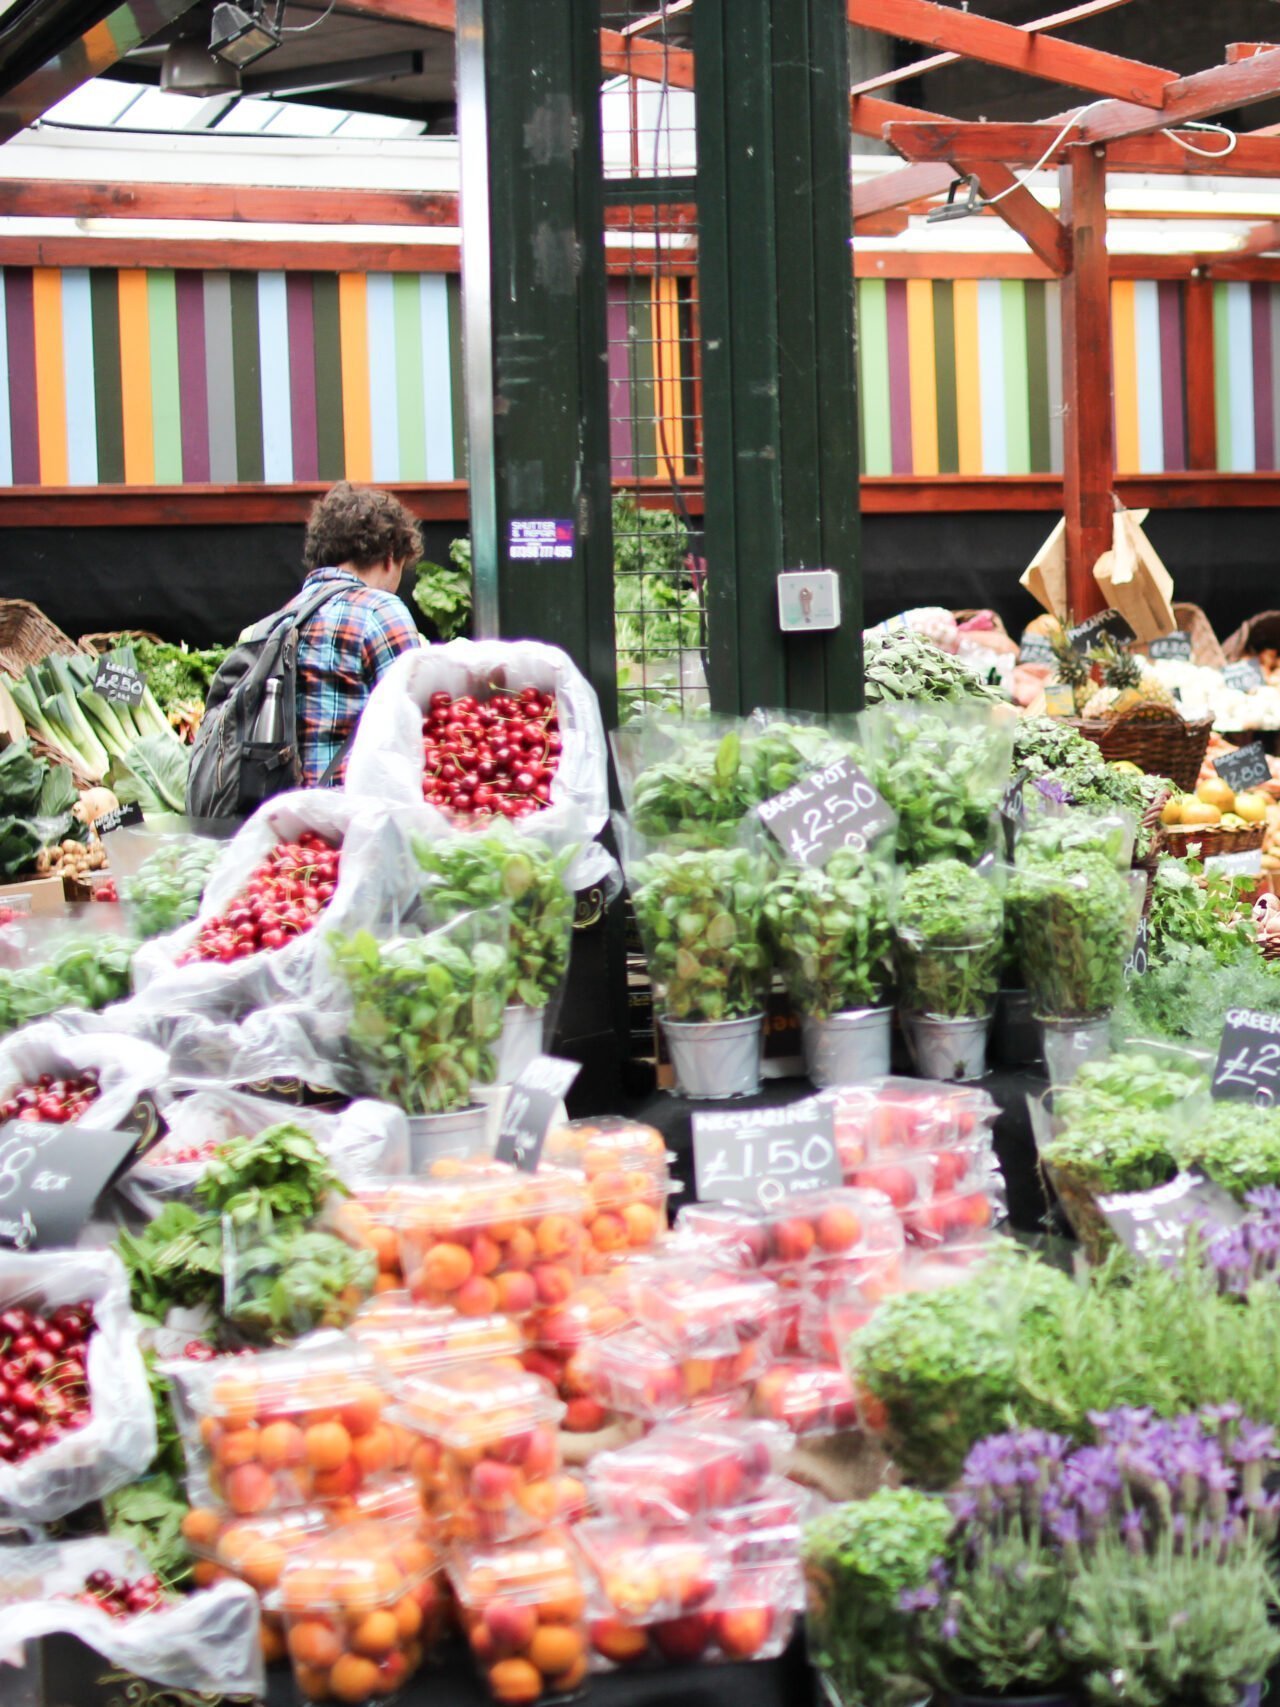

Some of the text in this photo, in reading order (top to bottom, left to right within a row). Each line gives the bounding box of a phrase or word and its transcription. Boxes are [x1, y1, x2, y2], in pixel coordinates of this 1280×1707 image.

[757, 787, 815, 821] BASIL
[790, 782, 878, 863] £2.50
[701, 1135, 834, 1189] £1.50
